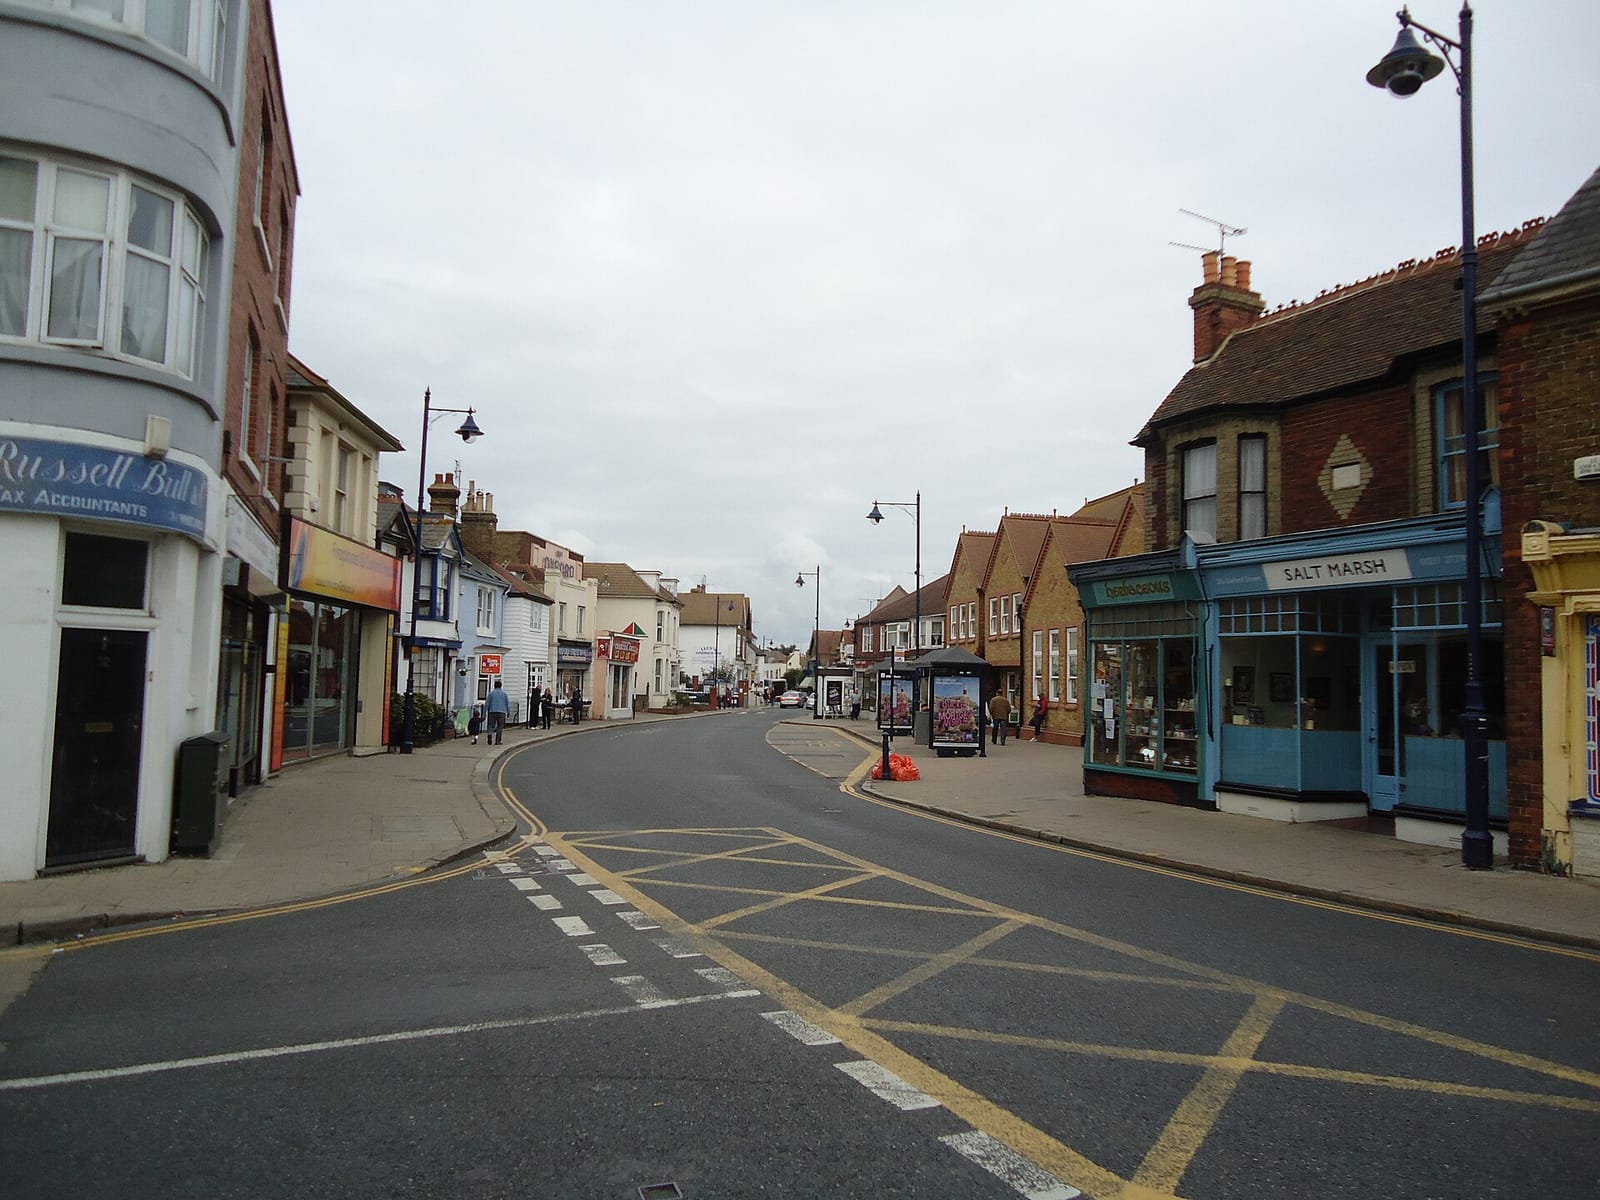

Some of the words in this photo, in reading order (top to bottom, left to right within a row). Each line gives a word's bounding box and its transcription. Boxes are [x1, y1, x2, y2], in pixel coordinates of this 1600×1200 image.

[0, 440, 134, 489] Russell
[138, 460, 193, 502] Bull
[34, 489, 148, 517] ACCOUNTANTS
[1284, 564, 1323, 582] SALT
[1327, 558, 1388, 578] MARSH
